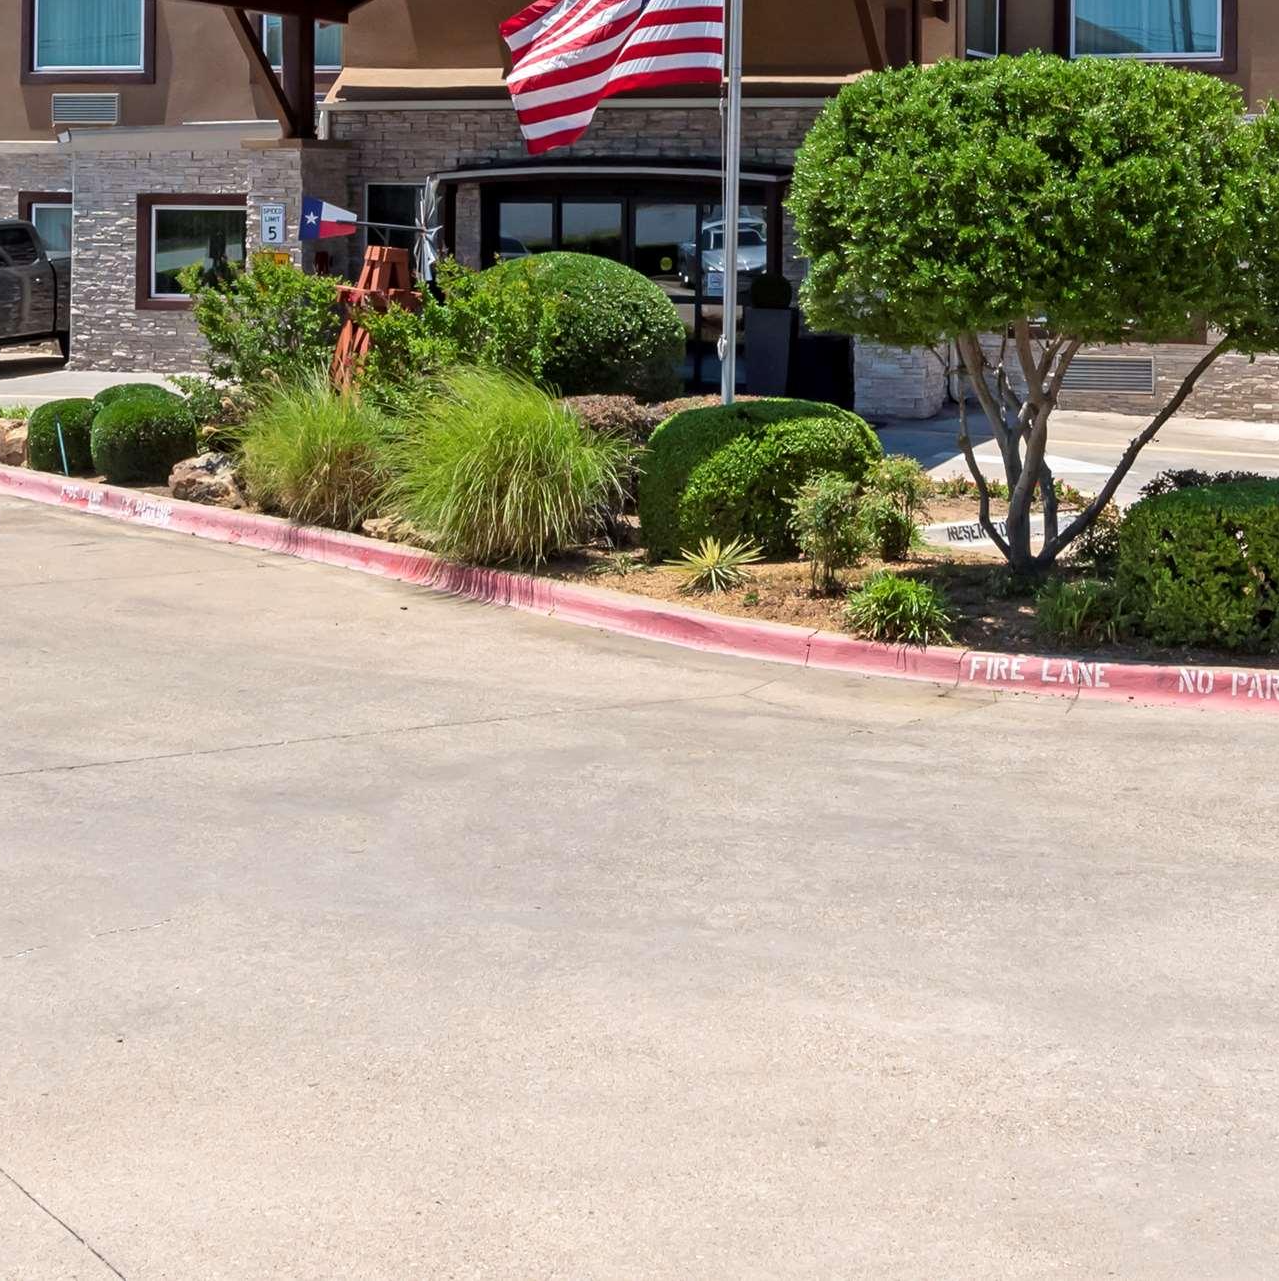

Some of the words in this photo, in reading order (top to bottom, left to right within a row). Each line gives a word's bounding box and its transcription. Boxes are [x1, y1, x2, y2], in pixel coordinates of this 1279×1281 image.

[268, 226, 277, 240] 5
[969, 656, 1028, 680] FIRE
[1041, 658, 1110, 687] LANE
[1178, 668, 1215, 694] NO
